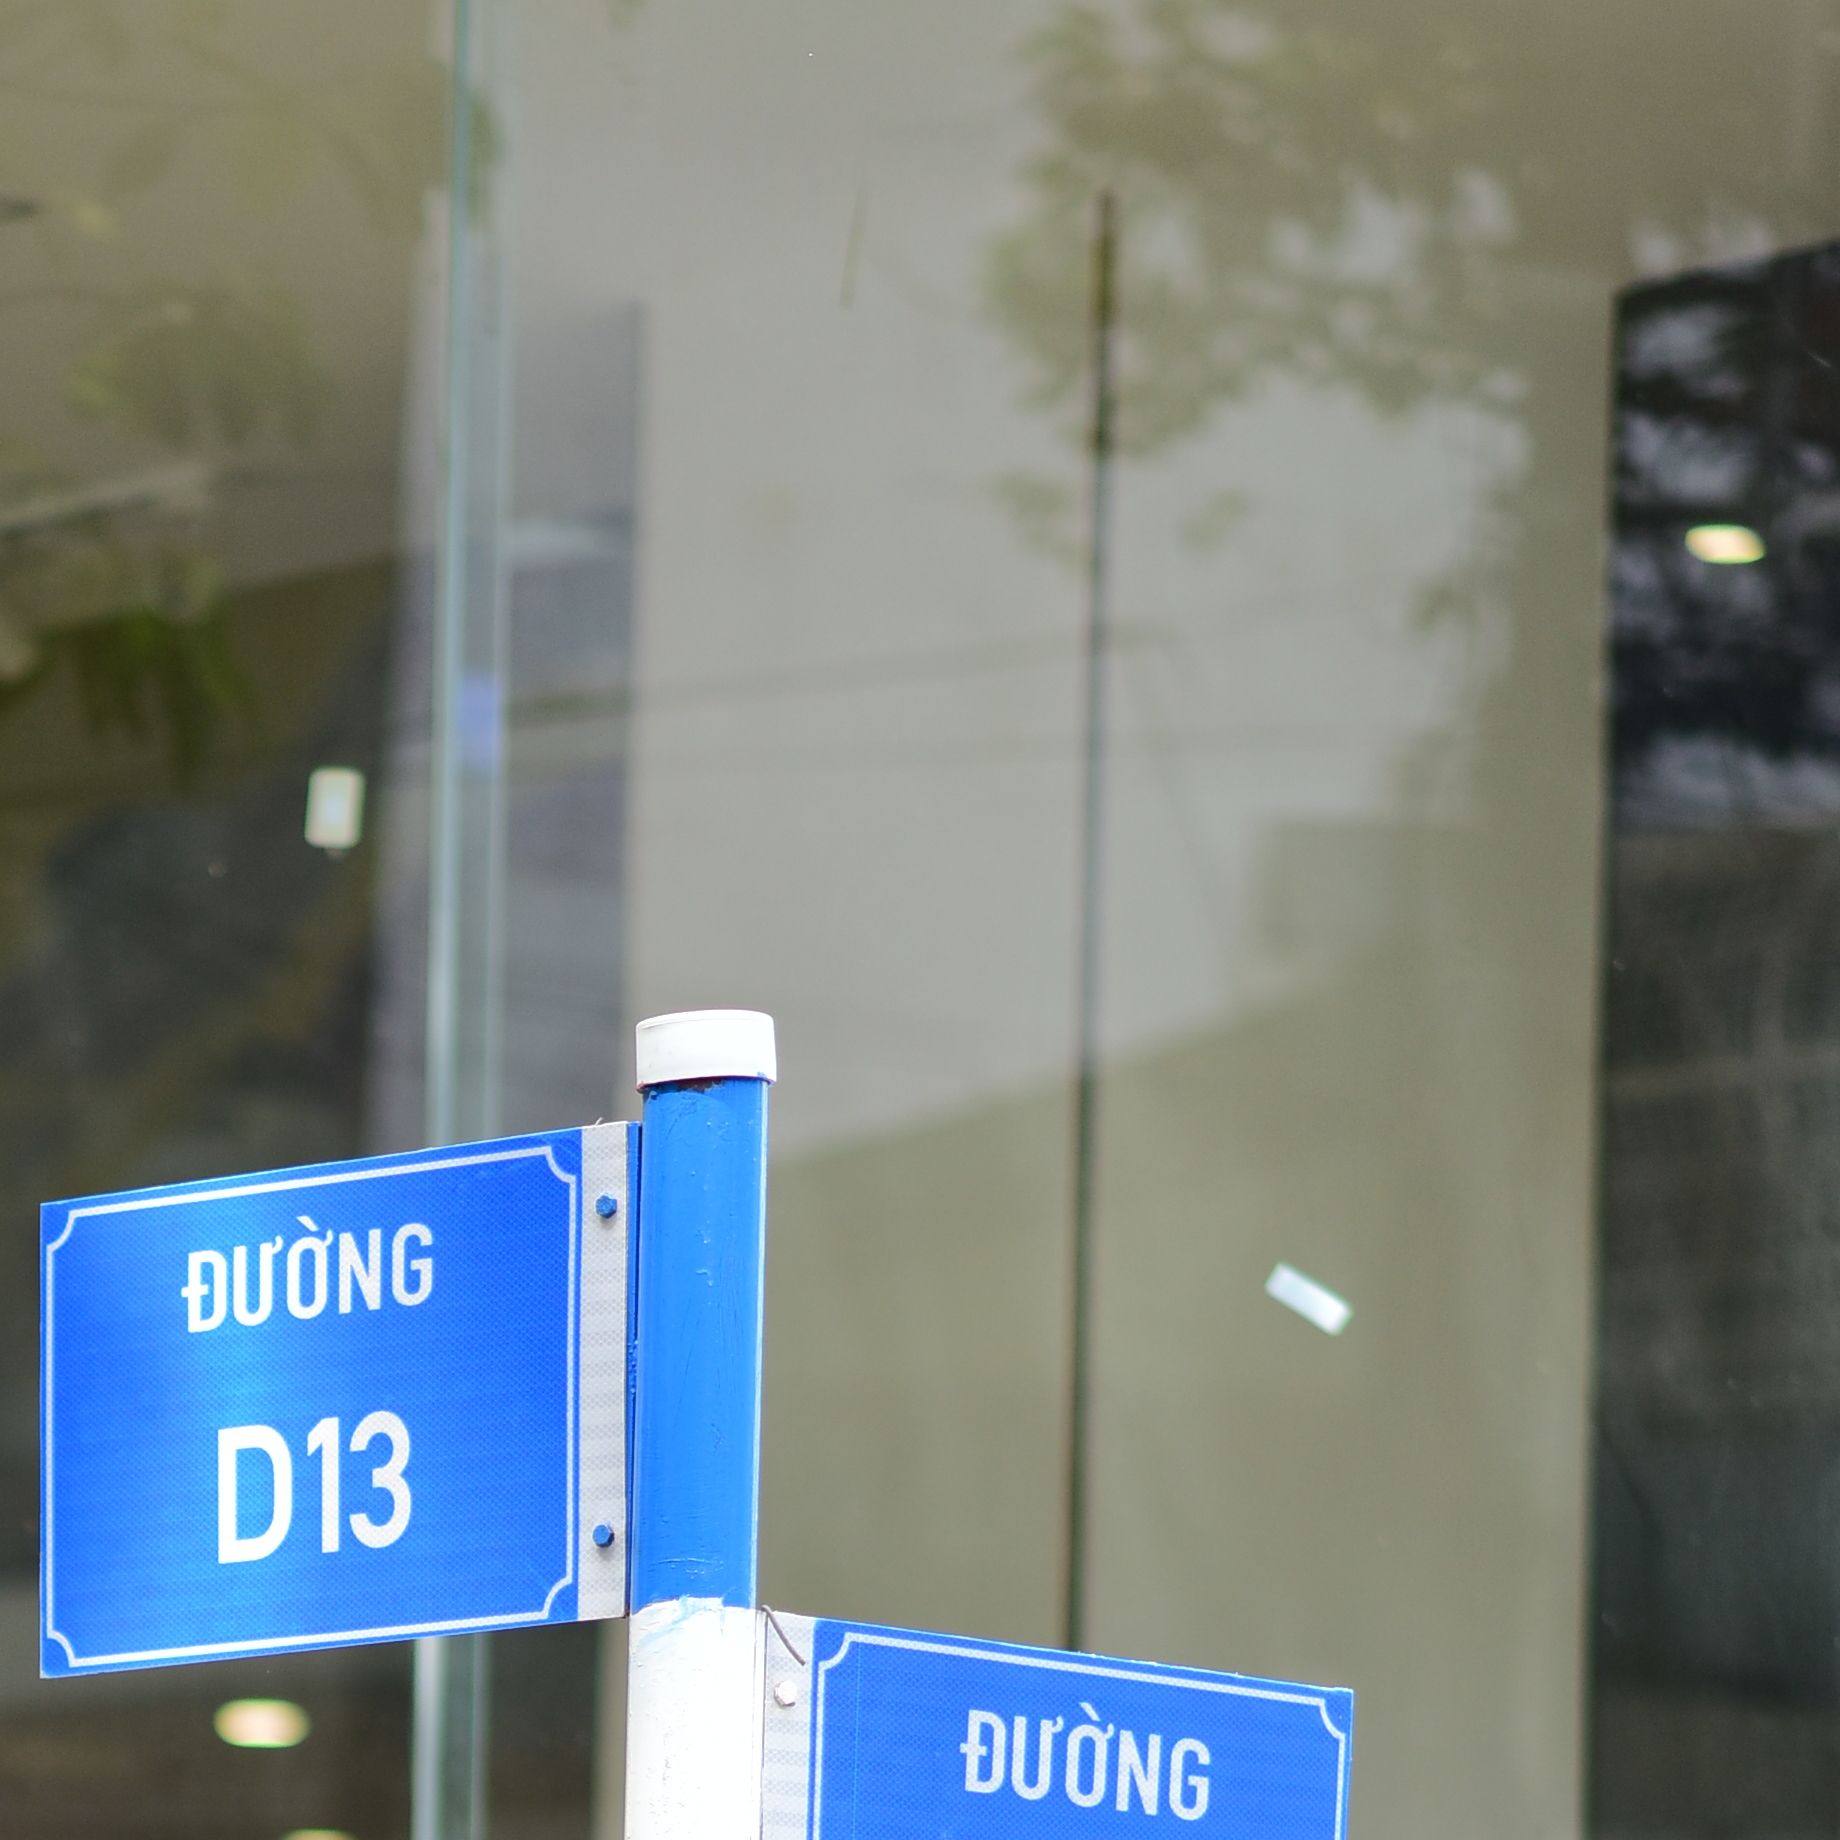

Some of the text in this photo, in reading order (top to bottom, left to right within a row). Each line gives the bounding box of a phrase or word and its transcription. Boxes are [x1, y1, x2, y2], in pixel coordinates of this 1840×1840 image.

[181, 1215, 433, 1333] ĐƯỜNG
[217, 1410, 412, 1564] D13
[959, 1702, 1211, 1821] ĐƯỜNG
